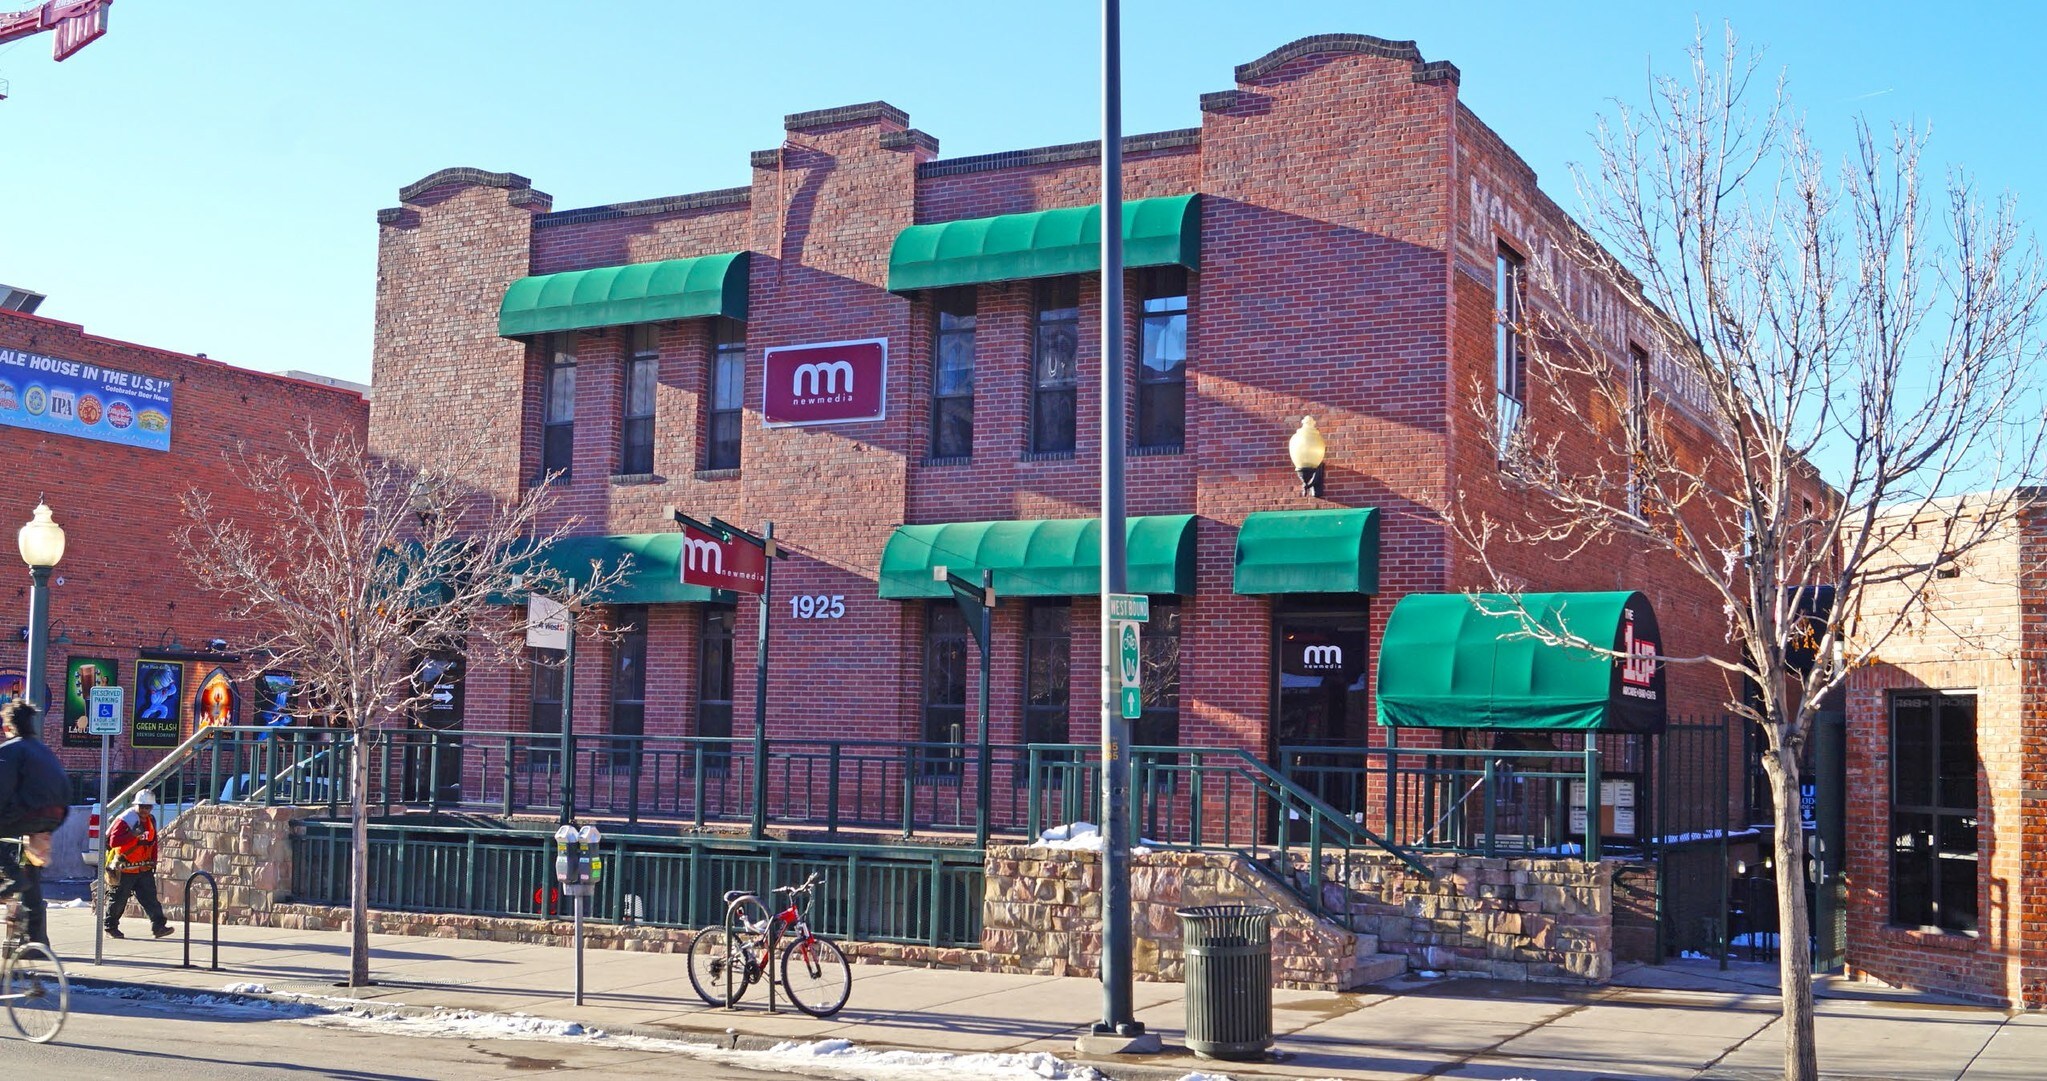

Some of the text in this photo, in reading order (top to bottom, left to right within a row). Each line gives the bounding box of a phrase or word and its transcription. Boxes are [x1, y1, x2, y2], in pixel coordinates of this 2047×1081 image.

[0, 350, 27, 367] ALE
[29, 356, 80, 377] HOUSE
[82, 366, 99, 381] IN
[102, 370, 128, 386] THE
[105, 385, 137, 398] Celebrator
[138, 390, 152, 400] Beer
[153, 394, 169, 403] News
[793, 393, 853, 406] newmedia
[51, 396, 73, 416] IPA
[721, 569, 764, 582] newmedia
[789, 595, 846, 619] 1925
[1624, 608, 1635, 621] THE
[136, 722, 177, 732] GREEN FLASH
